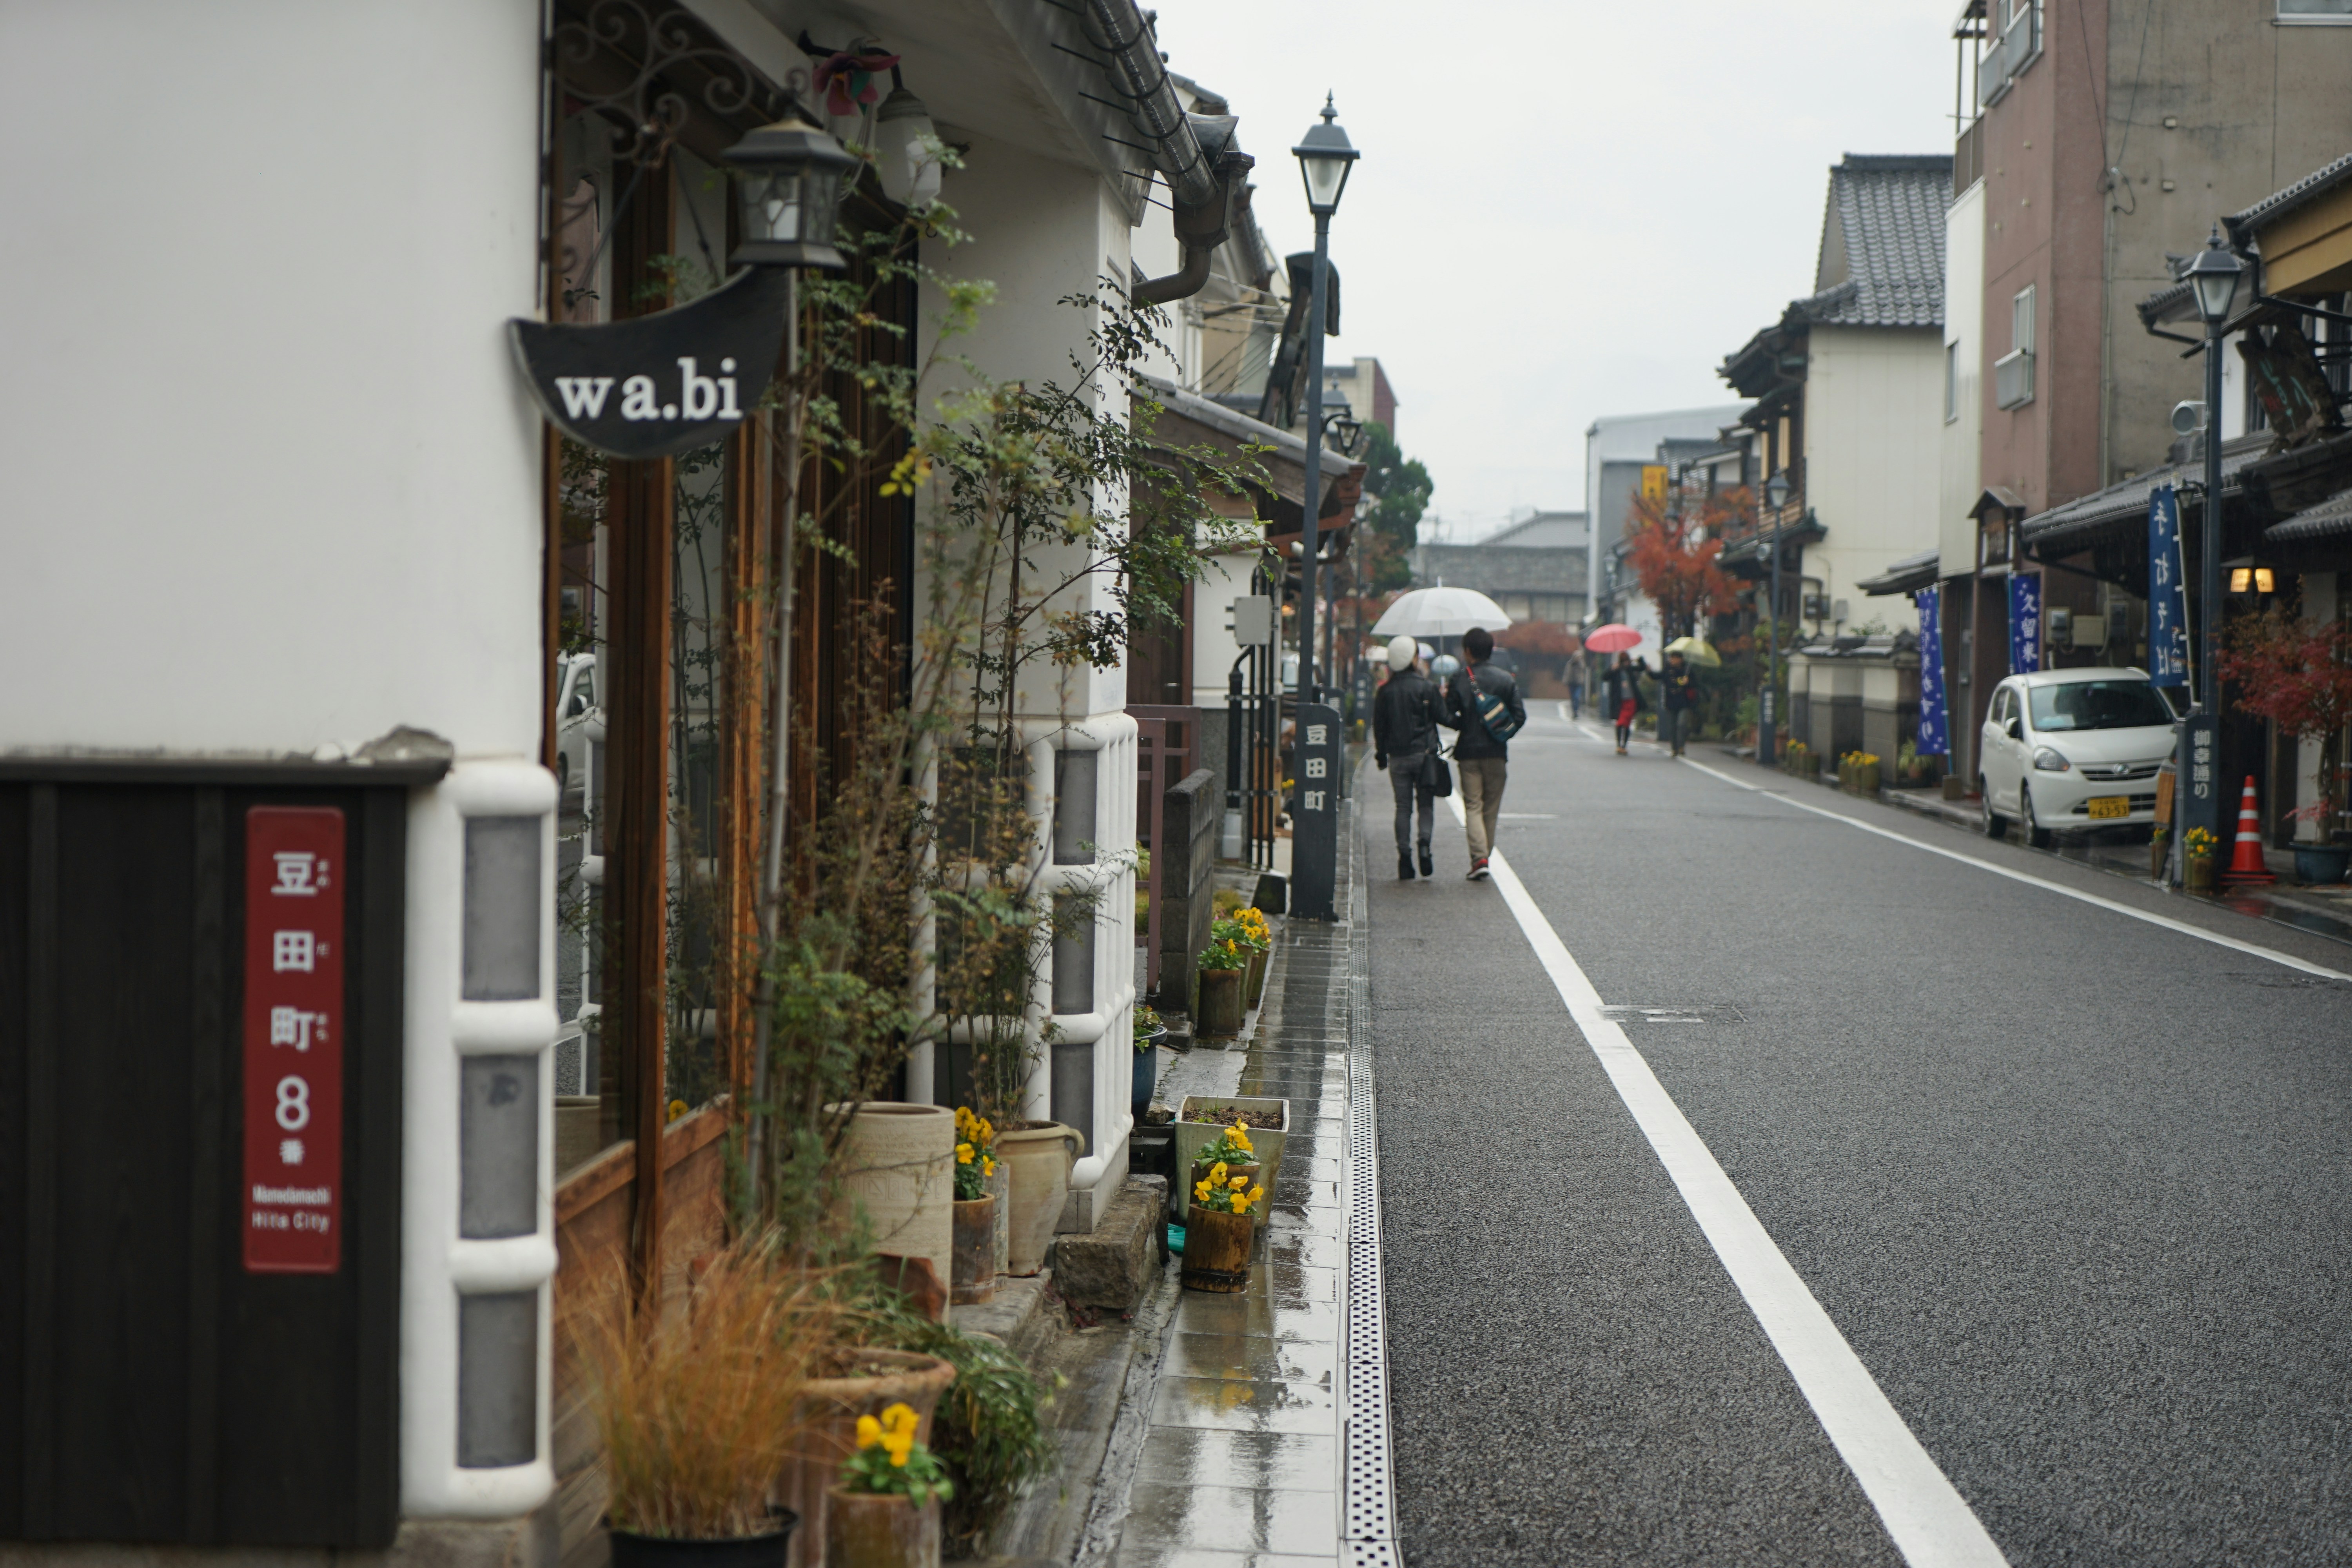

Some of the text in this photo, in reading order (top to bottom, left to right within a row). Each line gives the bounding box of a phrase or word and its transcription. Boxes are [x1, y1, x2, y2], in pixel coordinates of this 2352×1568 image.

[2021, 593, 2038, 673] 久留米
[1305, 724, 1327, 811] 豆田町
